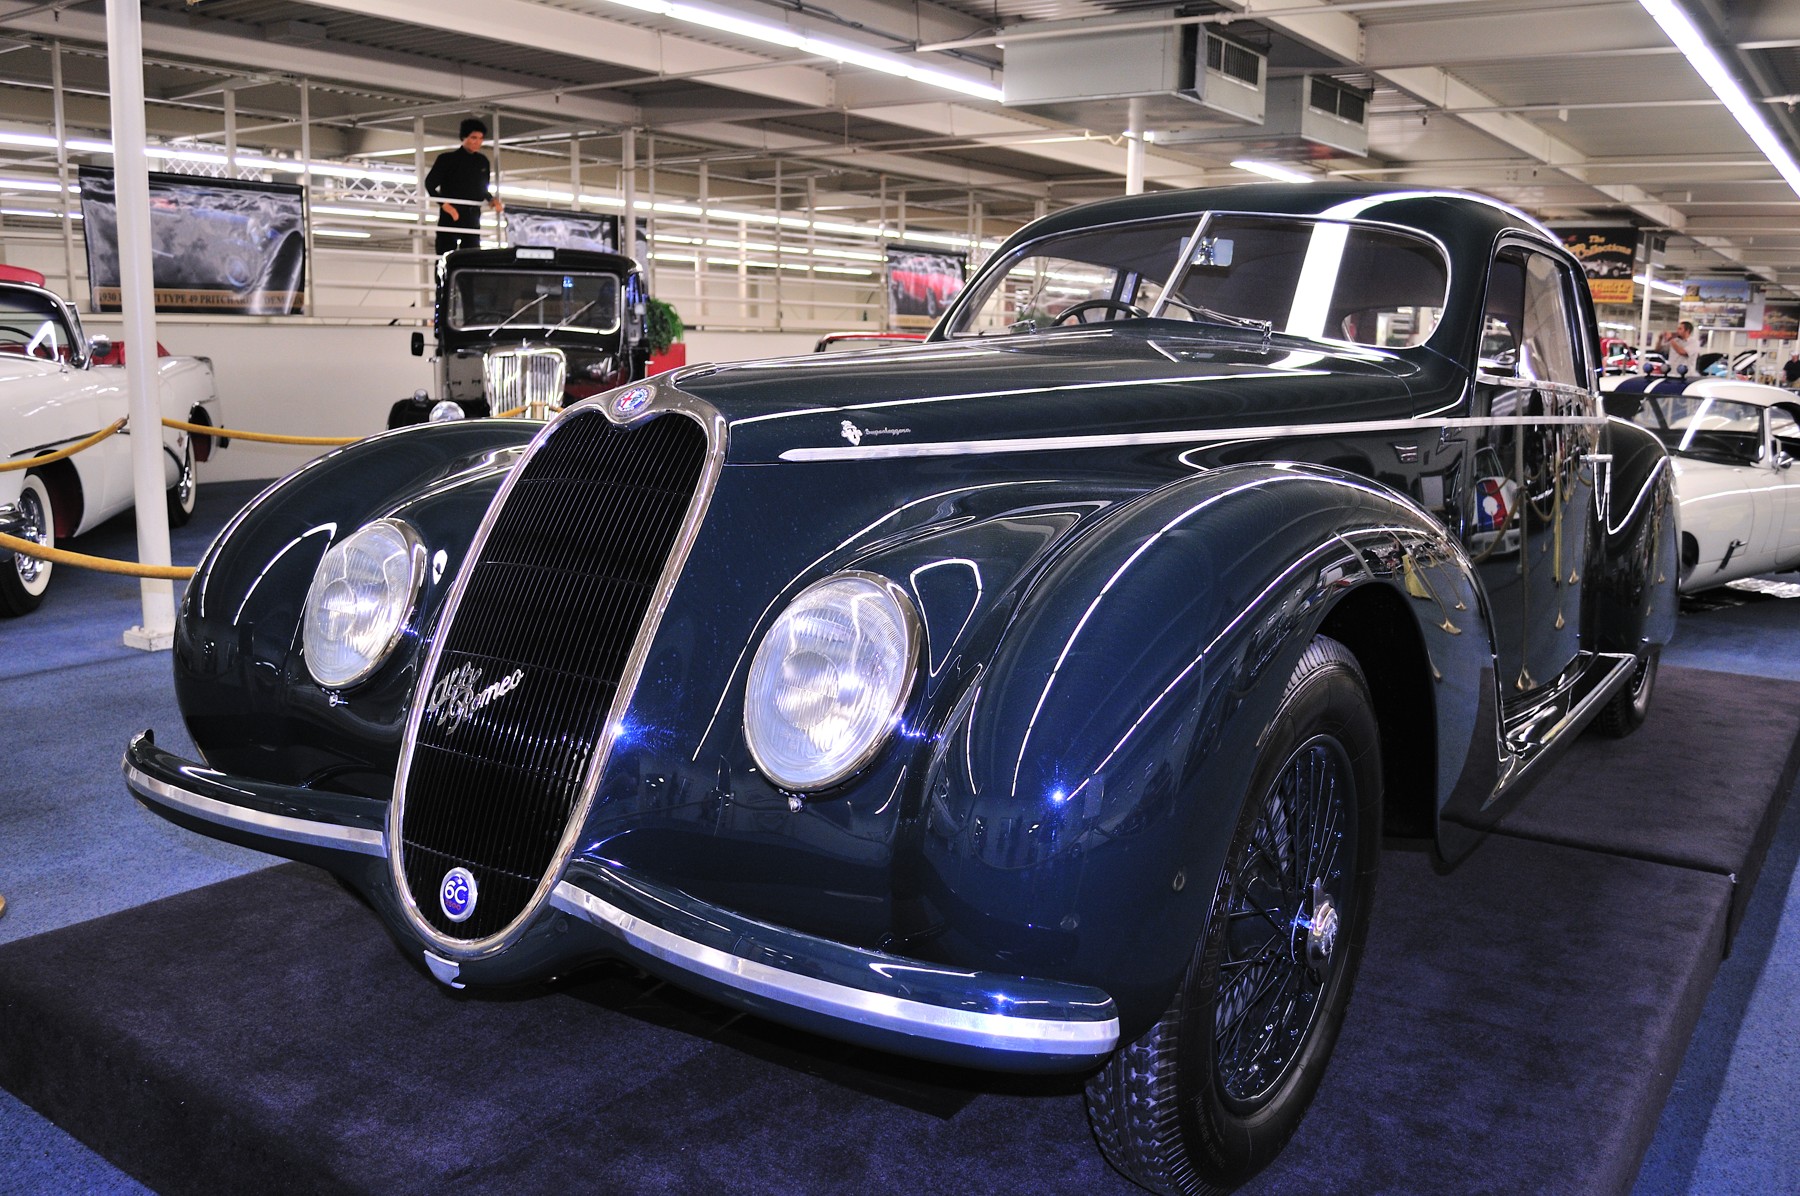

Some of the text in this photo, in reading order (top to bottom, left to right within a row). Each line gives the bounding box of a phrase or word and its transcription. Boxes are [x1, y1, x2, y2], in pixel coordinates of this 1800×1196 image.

[164, 293, 187, 304] TYPE
[190, 295, 198, 304] 49
[444, 880, 468, 905] 6C
